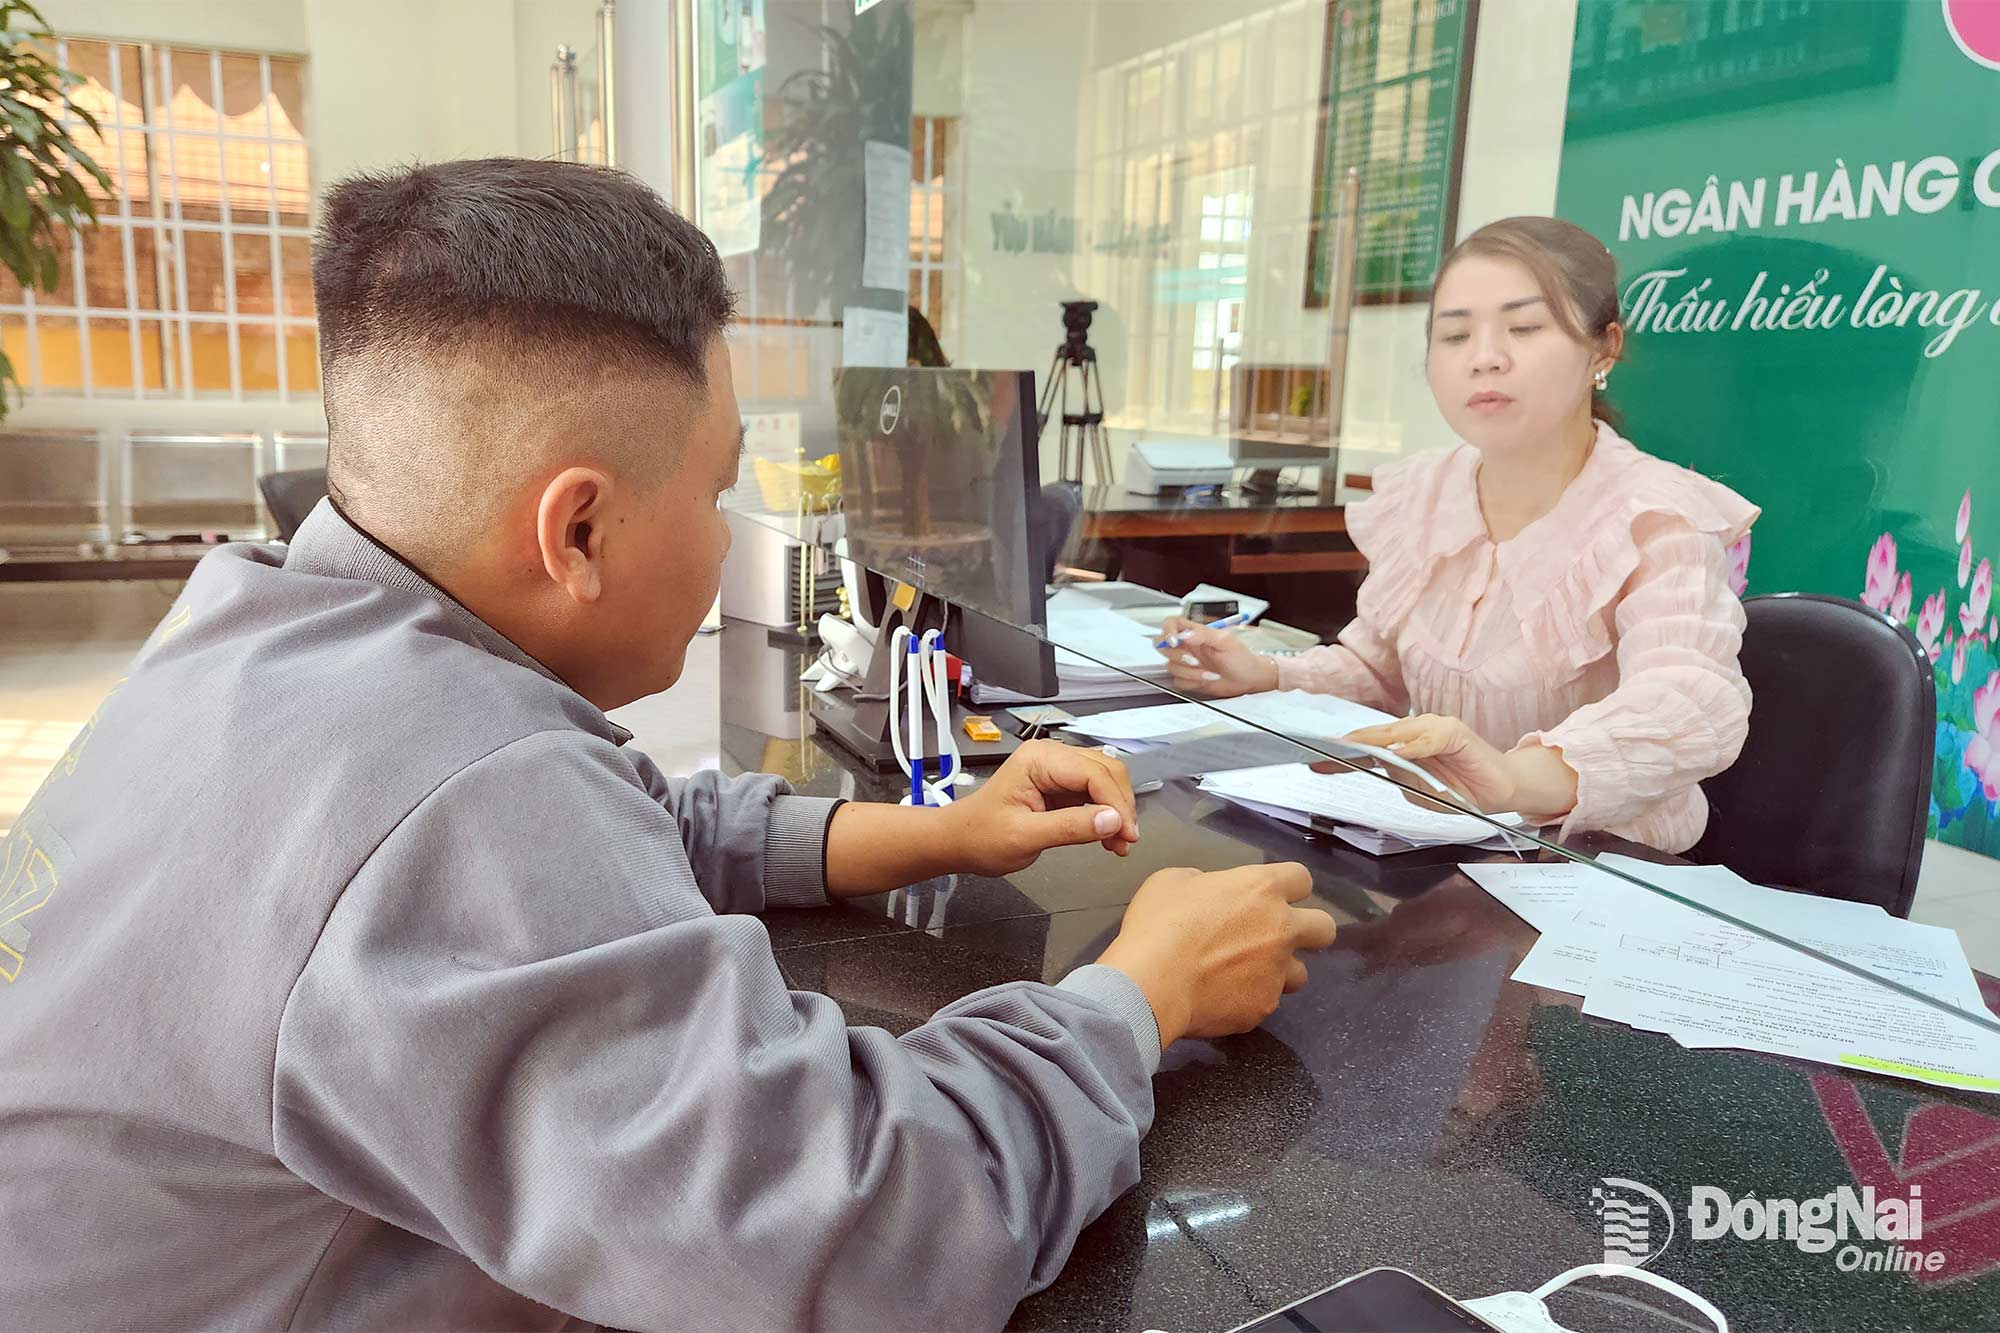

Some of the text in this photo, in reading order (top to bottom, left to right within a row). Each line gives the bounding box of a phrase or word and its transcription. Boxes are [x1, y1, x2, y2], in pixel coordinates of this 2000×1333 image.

[1618, 174, 1766, 241] NGÂN
[1775, 155, 1960, 227] HÀNG
[1622, 267, 1731, 334] Thấu
[1732, 268, 1848, 331] hiểu
[1849, 264, 1989, 358] lòng
